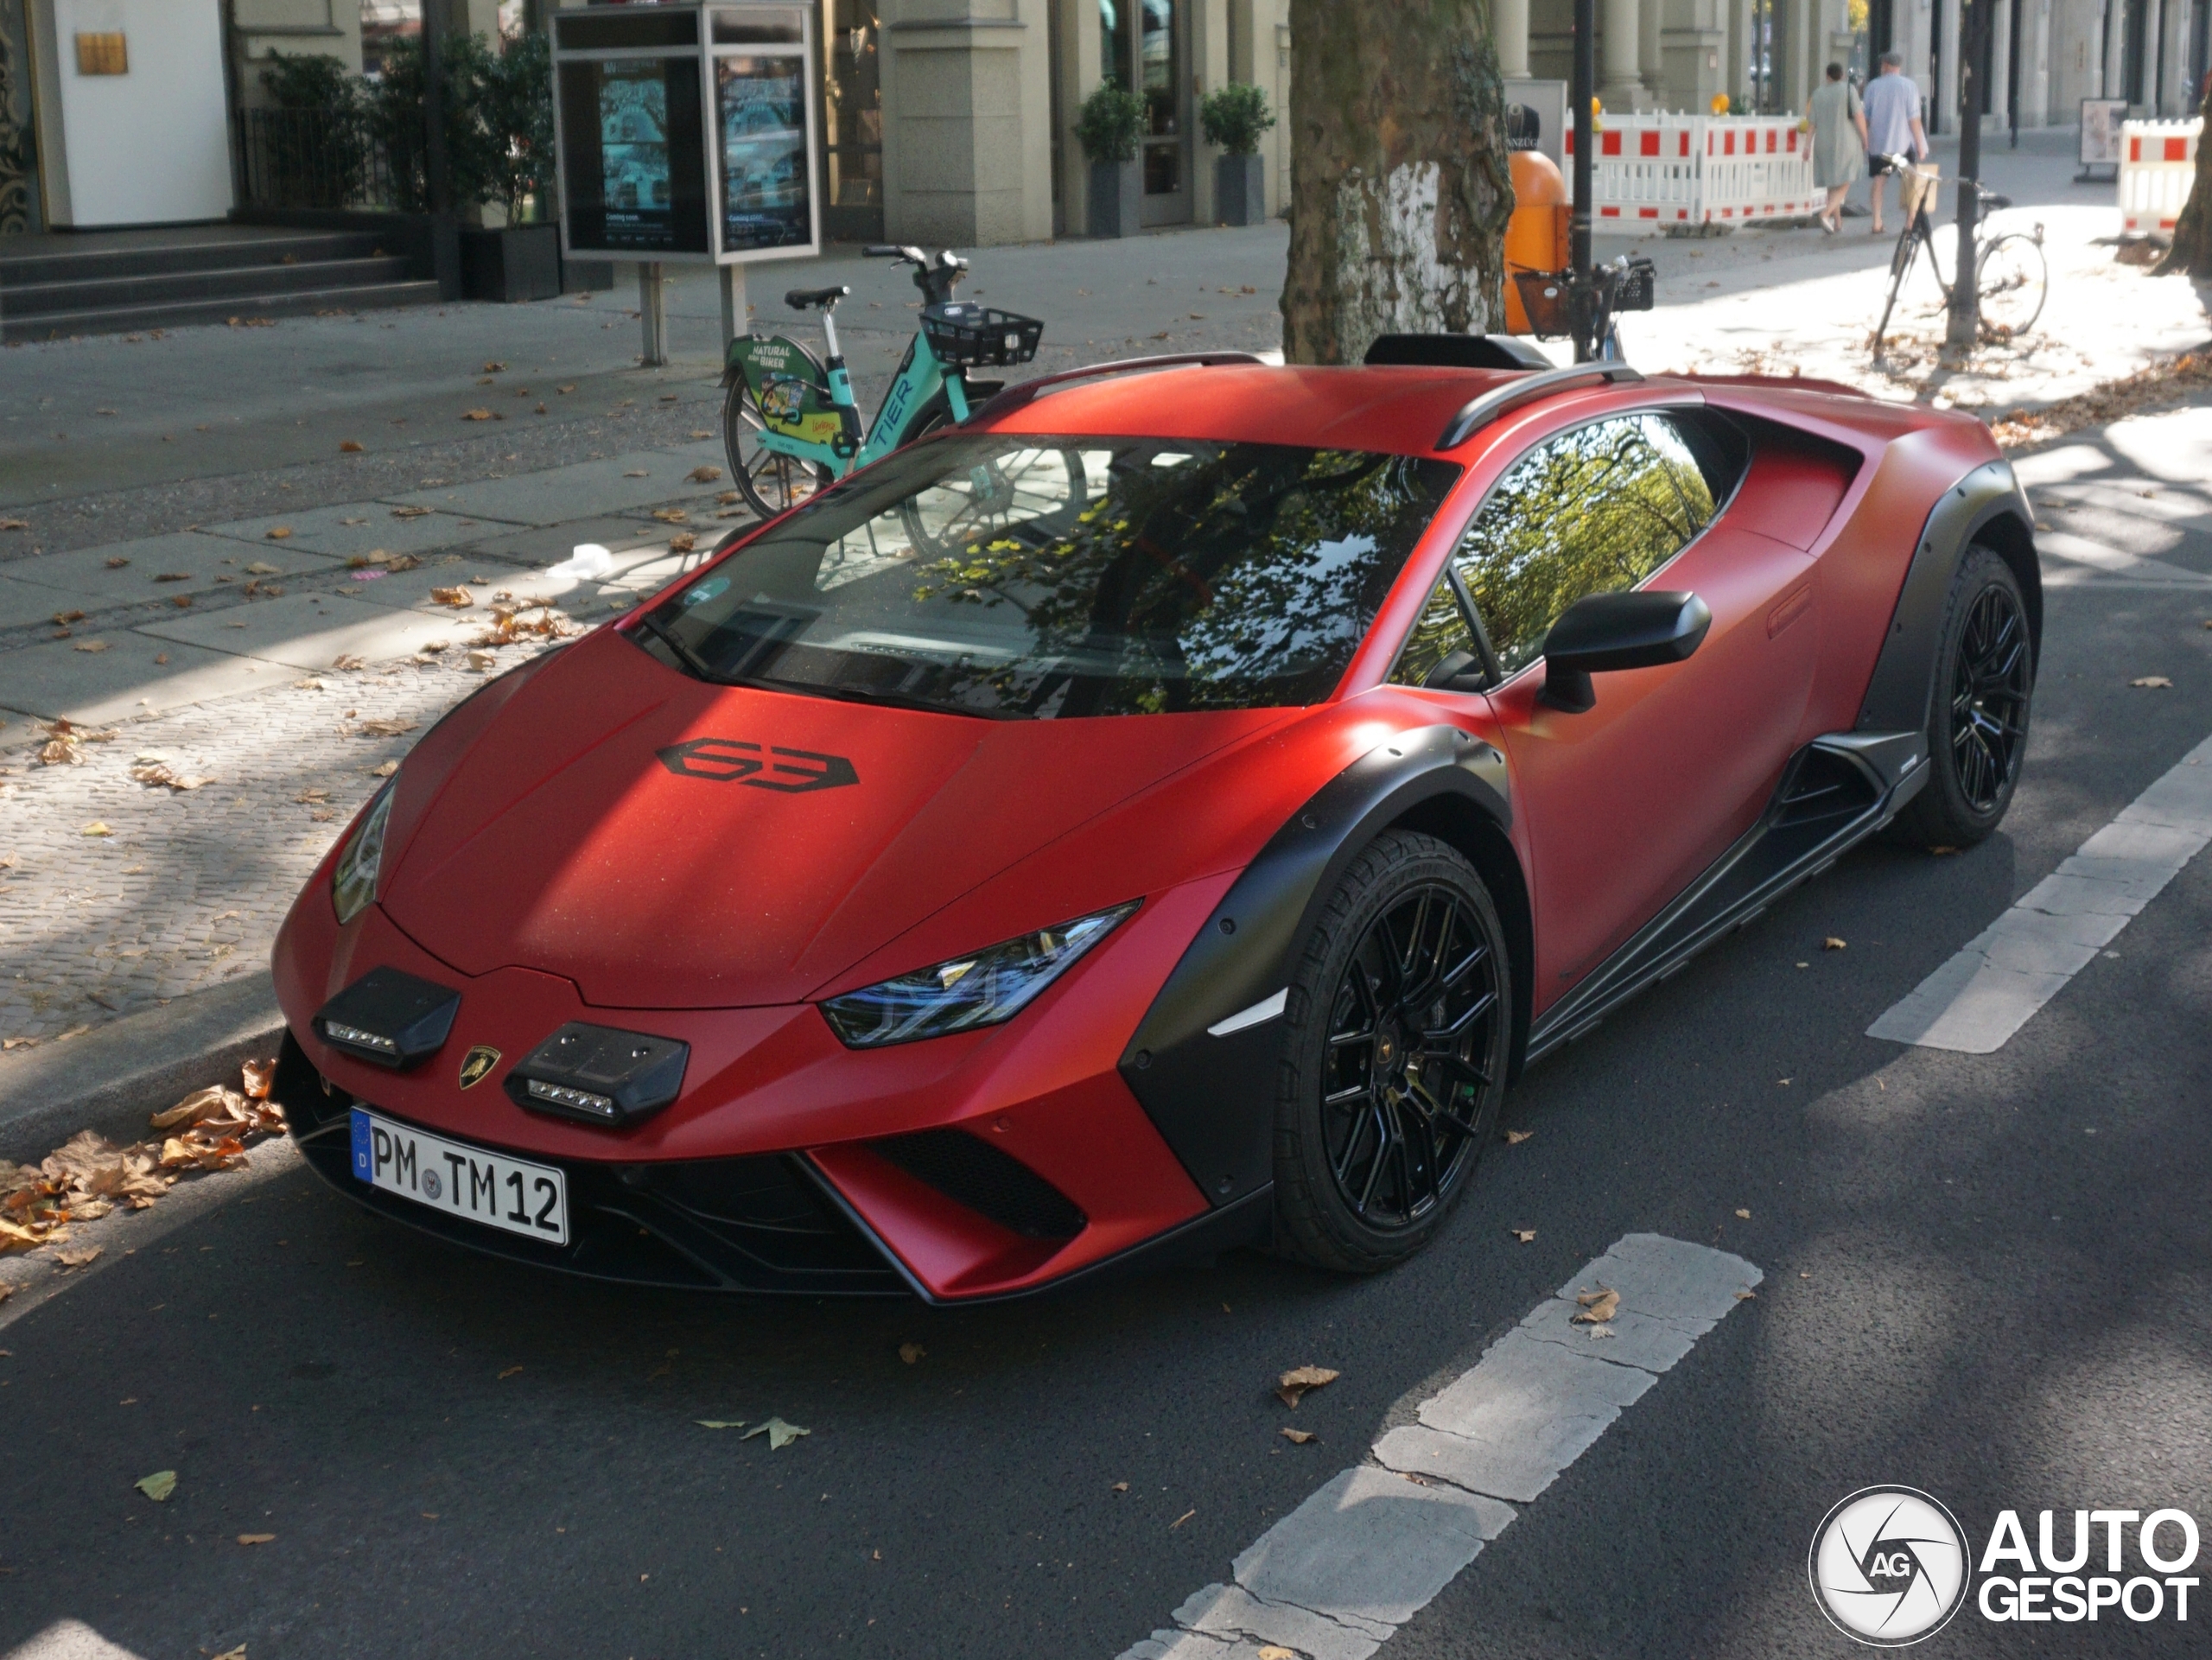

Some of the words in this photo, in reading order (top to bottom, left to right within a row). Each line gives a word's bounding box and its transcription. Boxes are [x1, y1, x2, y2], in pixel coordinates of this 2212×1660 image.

[1507, 137, 1543, 148] ANZÜG
[753, 346, 790, 357] NATURAL
[760, 356, 785, 369] BIKER
[874, 378, 913, 445] TIER
[655, 737, 861, 793] 63
[359, 1153, 366, 1167] D
[372, 1126, 416, 1191] PM
[442, 1151, 496, 1216] TM
[505, 1171, 560, 1233] 12
